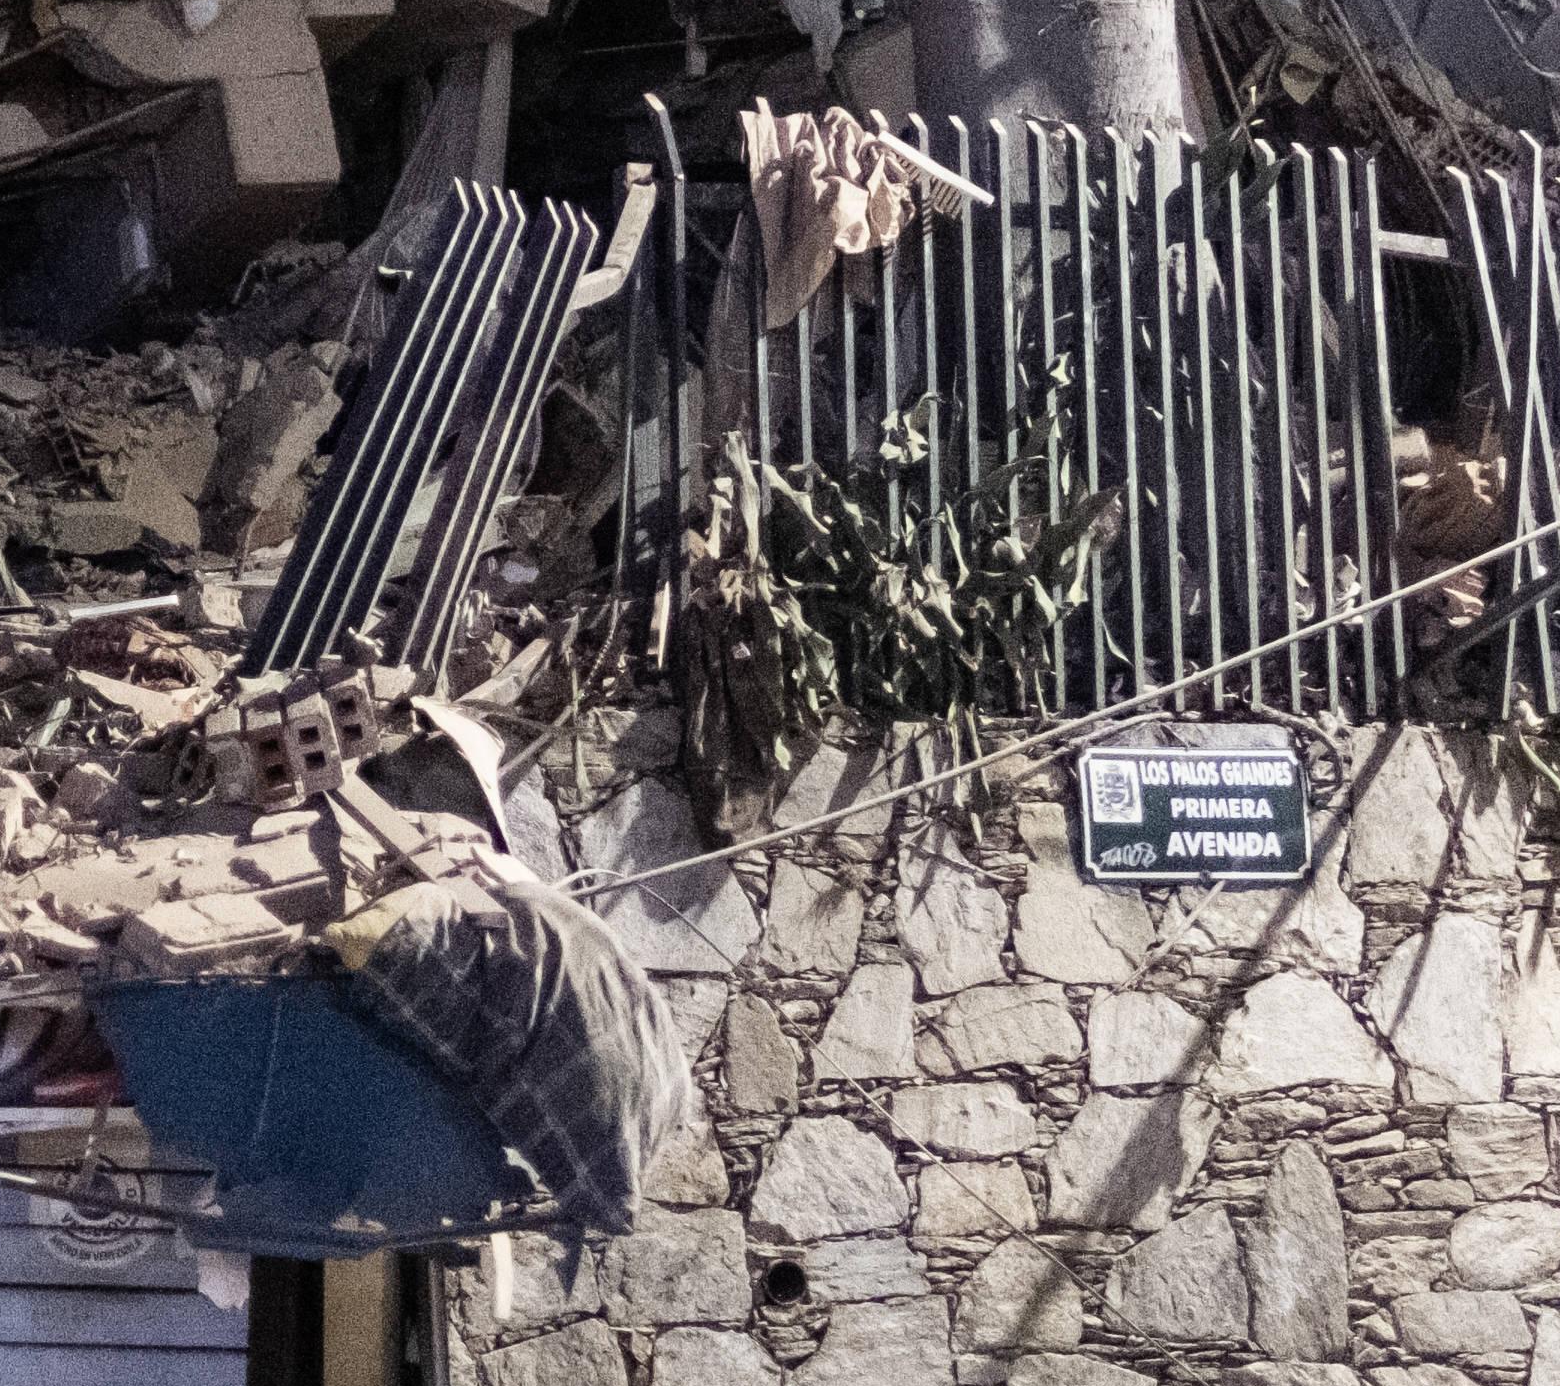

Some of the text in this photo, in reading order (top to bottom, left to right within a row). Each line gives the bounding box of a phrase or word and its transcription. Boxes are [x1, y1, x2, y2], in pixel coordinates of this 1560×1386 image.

[1139, 761, 1293, 786] LOS PALOS GRANDES
[1170, 798, 1273, 819] PRIMERA
[1166, 832, 1282, 857] AVENIDA
